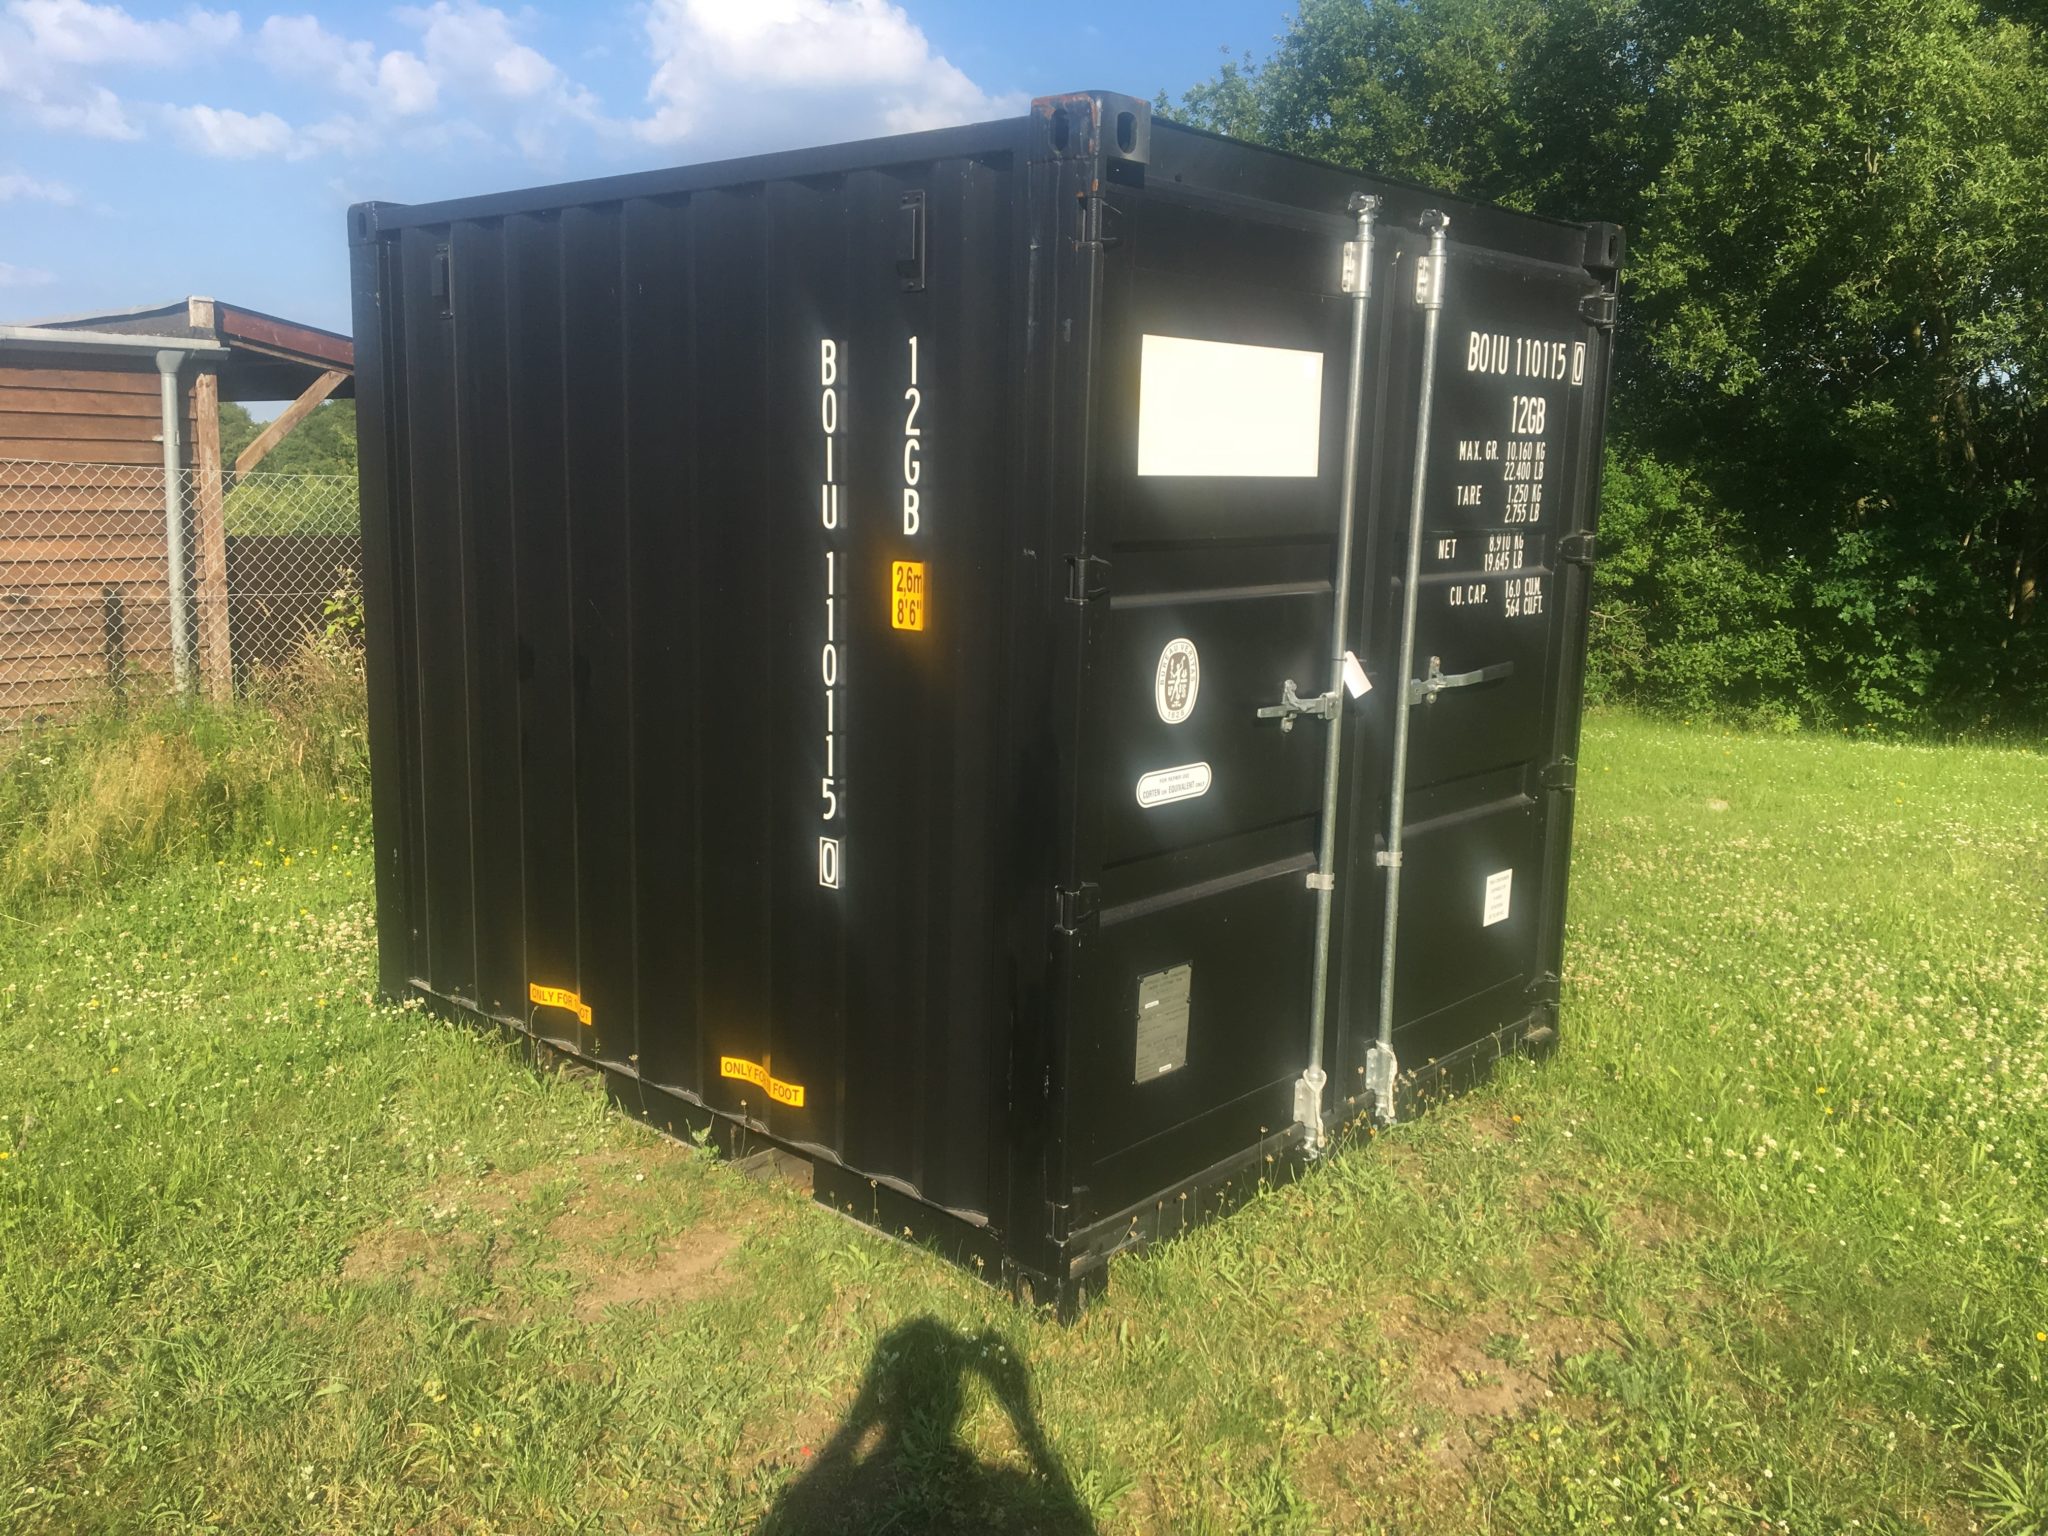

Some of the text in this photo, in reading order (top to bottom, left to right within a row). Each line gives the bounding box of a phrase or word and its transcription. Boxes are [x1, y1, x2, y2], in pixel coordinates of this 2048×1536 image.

[1467, 331, 1510, 375] BOIU
[1516, 338, 1567, 380] 110115
[1511, 396, 1546, 435] 12GB
[821, 339, 837, 530] BOIU
[904, 336, 921, 535] 12GB
[1459, 440, 1482, 461] MAX.
[1485, 440, 1499, 460] GR.
[1535, 441, 1546, 460] KG
[1533, 461, 1544, 480] LB
[1457, 485, 1483, 506] TARE
[1531, 484, 1542, 503] KG
[1529, 503, 1540, 522] LB
[1438, 539, 1457, 559] NET
[1514, 532, 1524, 550] KG
[1513, 551, 1523, 569] LB
[1450, 586, 1465, 606] CU.
[1468, 584, 1488, 604] CAP.
[1505, 579, 1521, 598] 16.0
[1505, 598, 1520, 617] 564
[1159, 644, 1196, 685] BUREAU VERITAS
[822, 552, 837, 820] 110115
[532, 987, 554, 1002] ONLY
[724, 1061, 752, 1078] ONLY
[773, 1083, 800, 1102] FOOT
